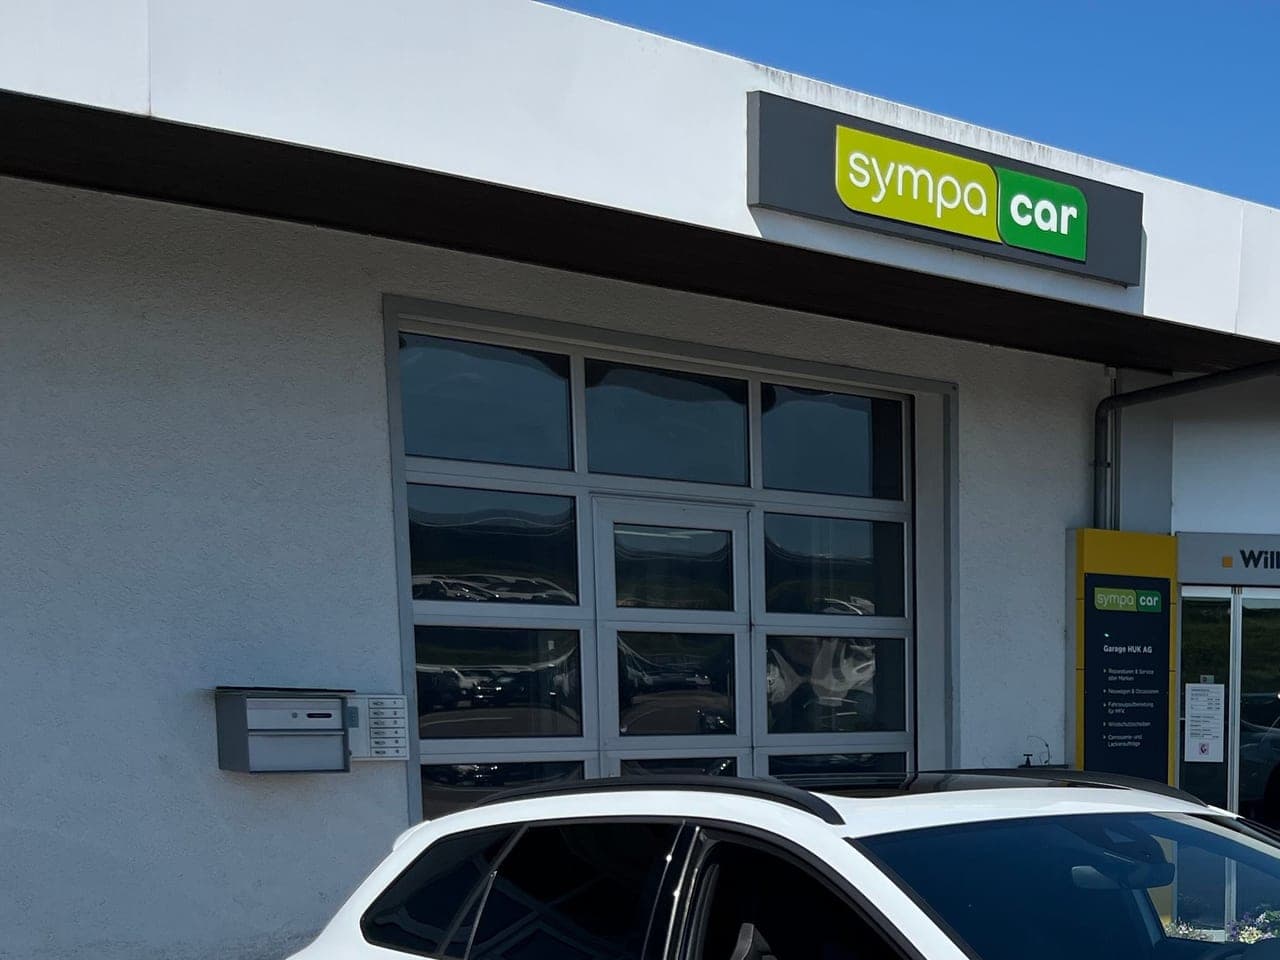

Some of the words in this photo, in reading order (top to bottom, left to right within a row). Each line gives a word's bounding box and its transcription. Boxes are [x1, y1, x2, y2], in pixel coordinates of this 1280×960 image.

[847, 151, 987, 218] sympa
[1009, 193, 1078, 235] car
[1096, 593, 1134, 608] sympa
[1139, 596, 1159, 606] car
[1103, 645, 1127, 654] Garage
[1142, 646, 1153, 654] AG
